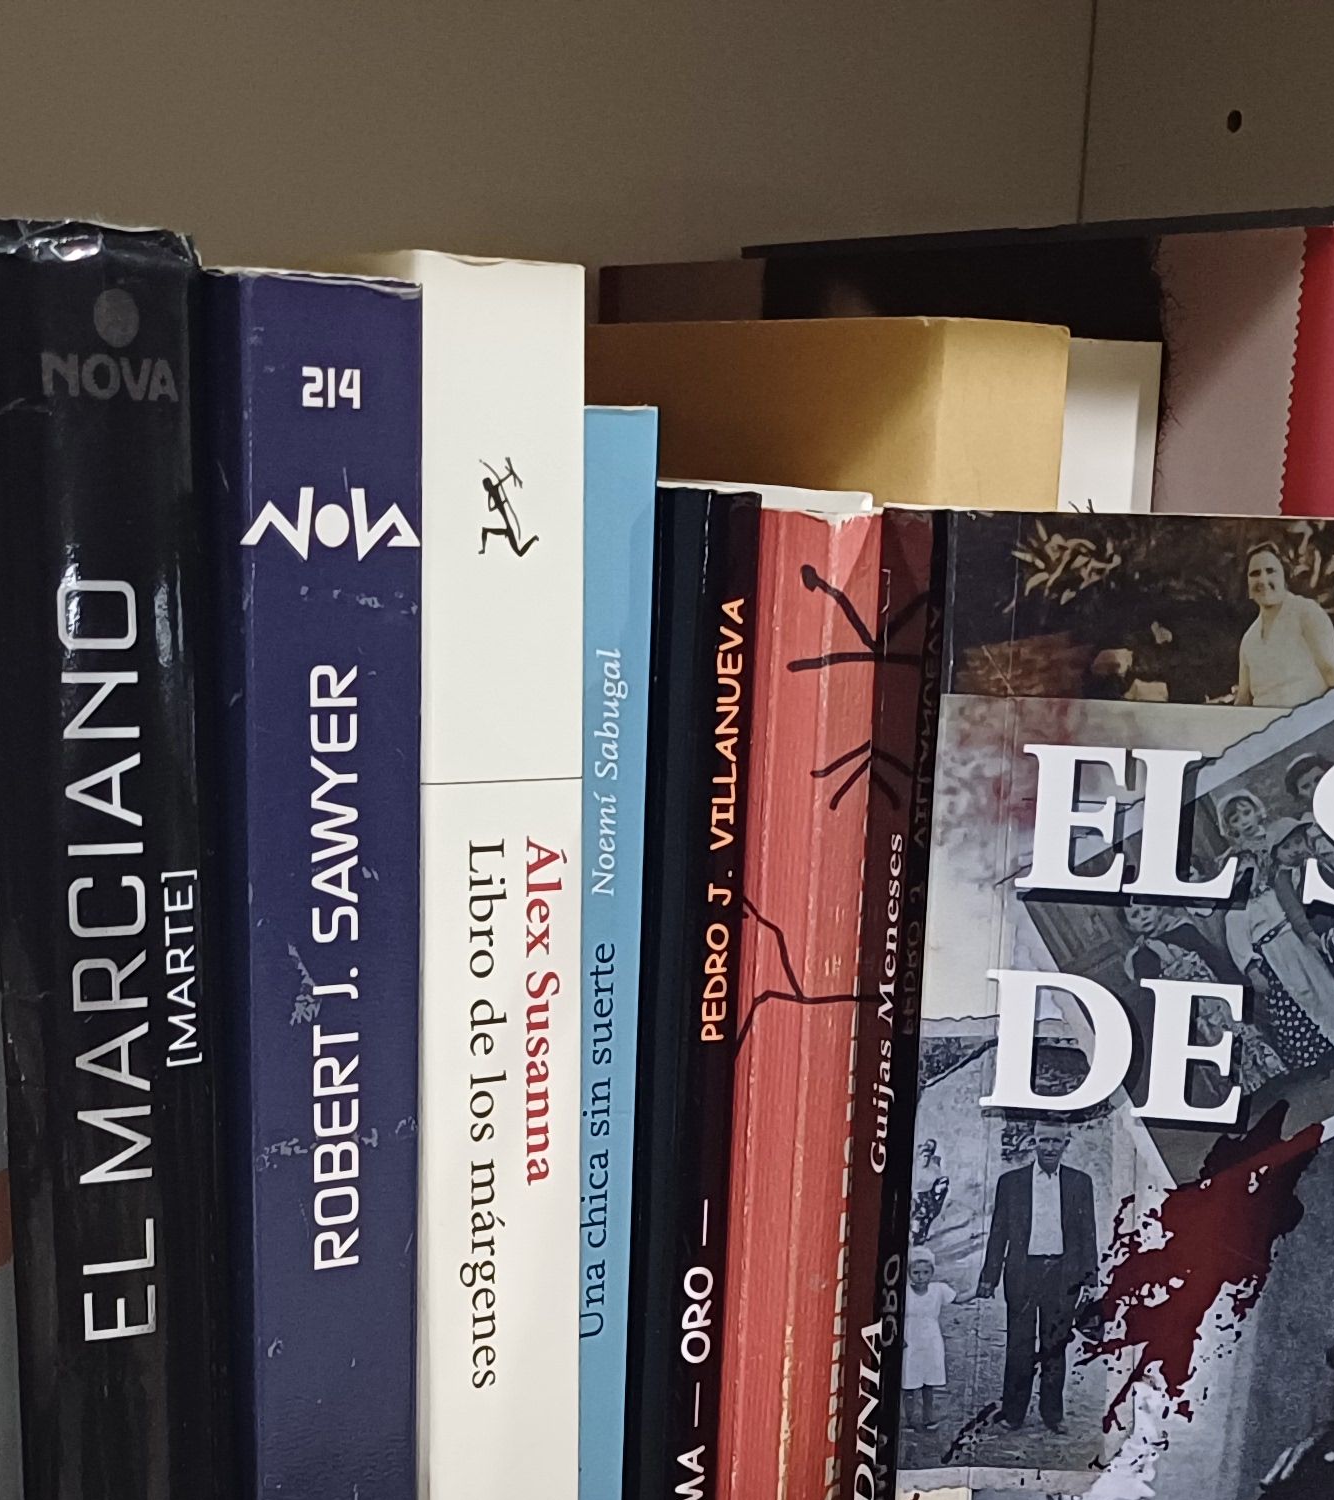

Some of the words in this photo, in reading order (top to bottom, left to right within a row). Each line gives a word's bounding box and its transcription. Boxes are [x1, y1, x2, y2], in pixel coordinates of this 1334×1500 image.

[41, 351, 179, 402] NOVA
[302, 367, 361, 409] 214
[594, 647, 628, 781] Sabugal
[709, 599, 744, 851] VILLANUEVA
[311, 664, 359, 942] SAWYER
[591, 790, 617, 897] Noemí
[1014, 743, 1243, 899] EL
[57, 579, 153, 1185] MARCIANO
[468, 839, 508, 978] Libro
[525, 836, 567, 958] Álex
[708, 867, 733, 905] J.
[878, 832, 904, 1028] Meneses
[162, 870, 203, 1067] [MARTE]
[312, 966, 359, 1000] J.
[469, 999, 508, 1055] de
[589, 942, 617, 1064] suerte
[700, 920, 731, 1042] PEDRO
[469, 1070, 508, 1143] los
[525, 972, 561, 1186] Susanna
[581, 1078, 612, 1137] sin
[870, 1039, 894, 1174] Guijas
[979, 968, 1244, 1124] DE
[312, 1025, 359, 1270] ROBERT
[579, 1148, 610, 1248] chica
[83, 1217, 157, 1342] EL
[459, 1159, 507, 1389] márgenes
[580, 1259, 607, 1340] Una
[681, 1266, 714, 1364] ORO
